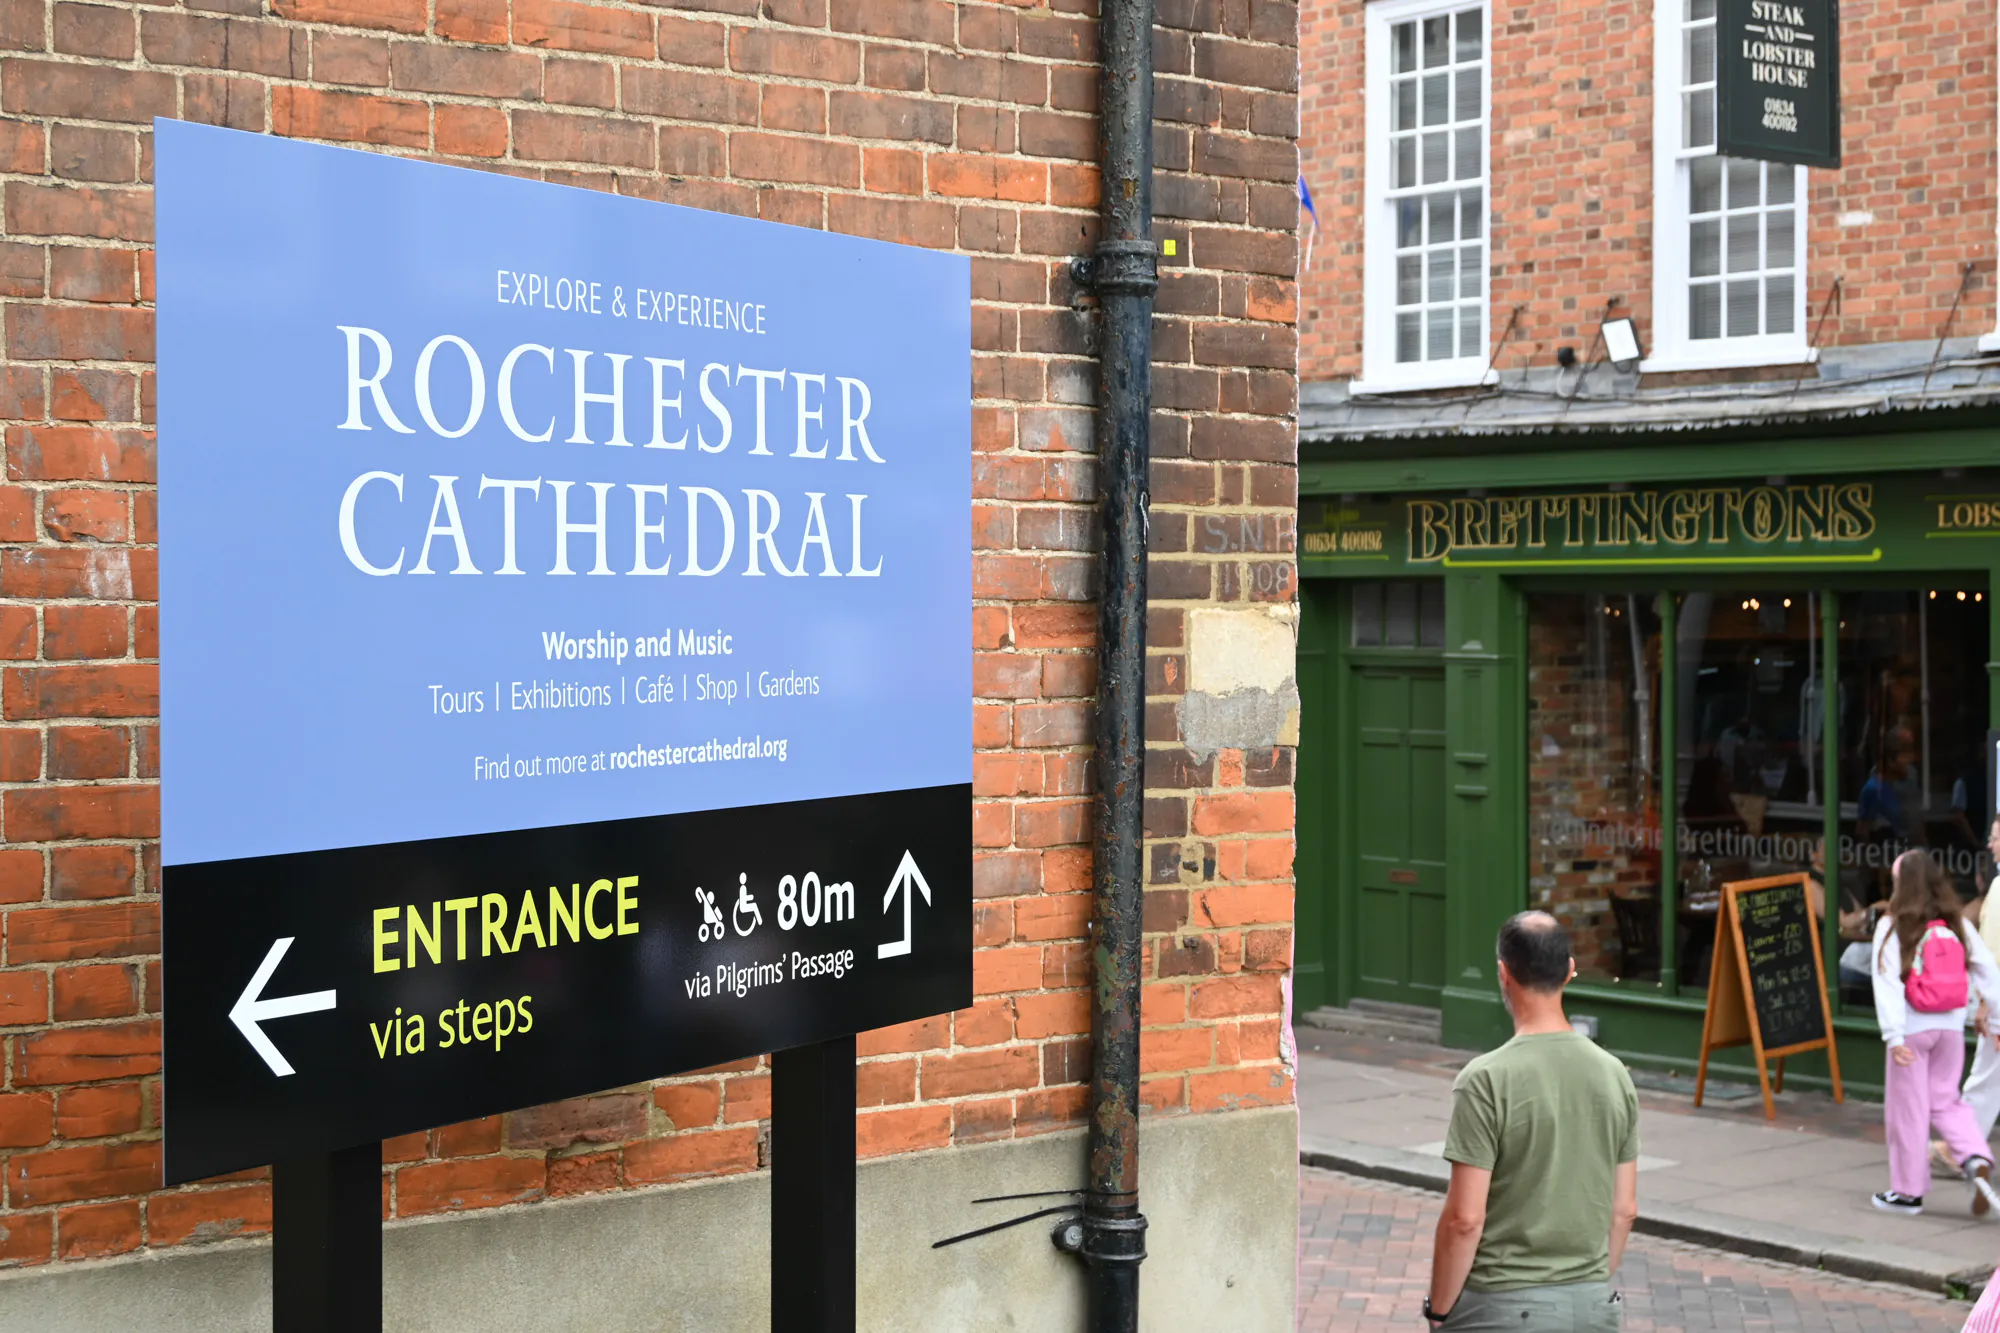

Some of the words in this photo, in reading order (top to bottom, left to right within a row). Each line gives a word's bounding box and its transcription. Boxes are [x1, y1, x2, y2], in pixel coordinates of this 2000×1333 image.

[1752, 1, 1805, 26] STEAK
[1766, 25, 1795, 43] AND
[1743, 39, 1815, 68] LOBSTER
[1752, 62, 1808, 88] HOUSE
[1762, 113, 1797, 132] 400192
[1764, 97, 1795, 115] 01634
[498, 270, 602, 315] EXPLORE
[612, 286, 627, 317] &
[637, 289, 766, 334] EXPERIENCE
[337, 325, 886, 463] ROCHESTER
[339, 471, 883, 577] CATHEDRAL
[1407, 483, 1876, 562] BRETTINGTONS
[1937, 502, 2000, 528] LOBS
[1304, 532, 1337, 552] 01634
[1341, 529, 1382, 552] 400192
[542, 630, 628, 665] Worship
[635, 628, 670, 657] and
[678, 629, 733, 656] Music
[429, 685, 484, 714] Tours
[512, 680, 611, 710] Exhibitions
[636, 675, 673, 703] Café
[697, 673, 737, 705] Shop
[759, 670, 820, 697] Gardens
[475, 754, 509, 780] Find
[514, 756, 542, 778] out
[546, 754, 587, 775] more
[591, 751, 606, 772] at
[610, 735, 788, 770] rochestercathedral.org
[777, 872, 855, 931] 80m
[374, 876, 639, 973] ENTRANCE
[684, 971, 711, 999] via
[717, 954, 787, 998] Pilgrims’
[792, 949, 854, 980] Passage
[370, 1007, 425, 1059] via
[439, 996, 533, 1052] steps
